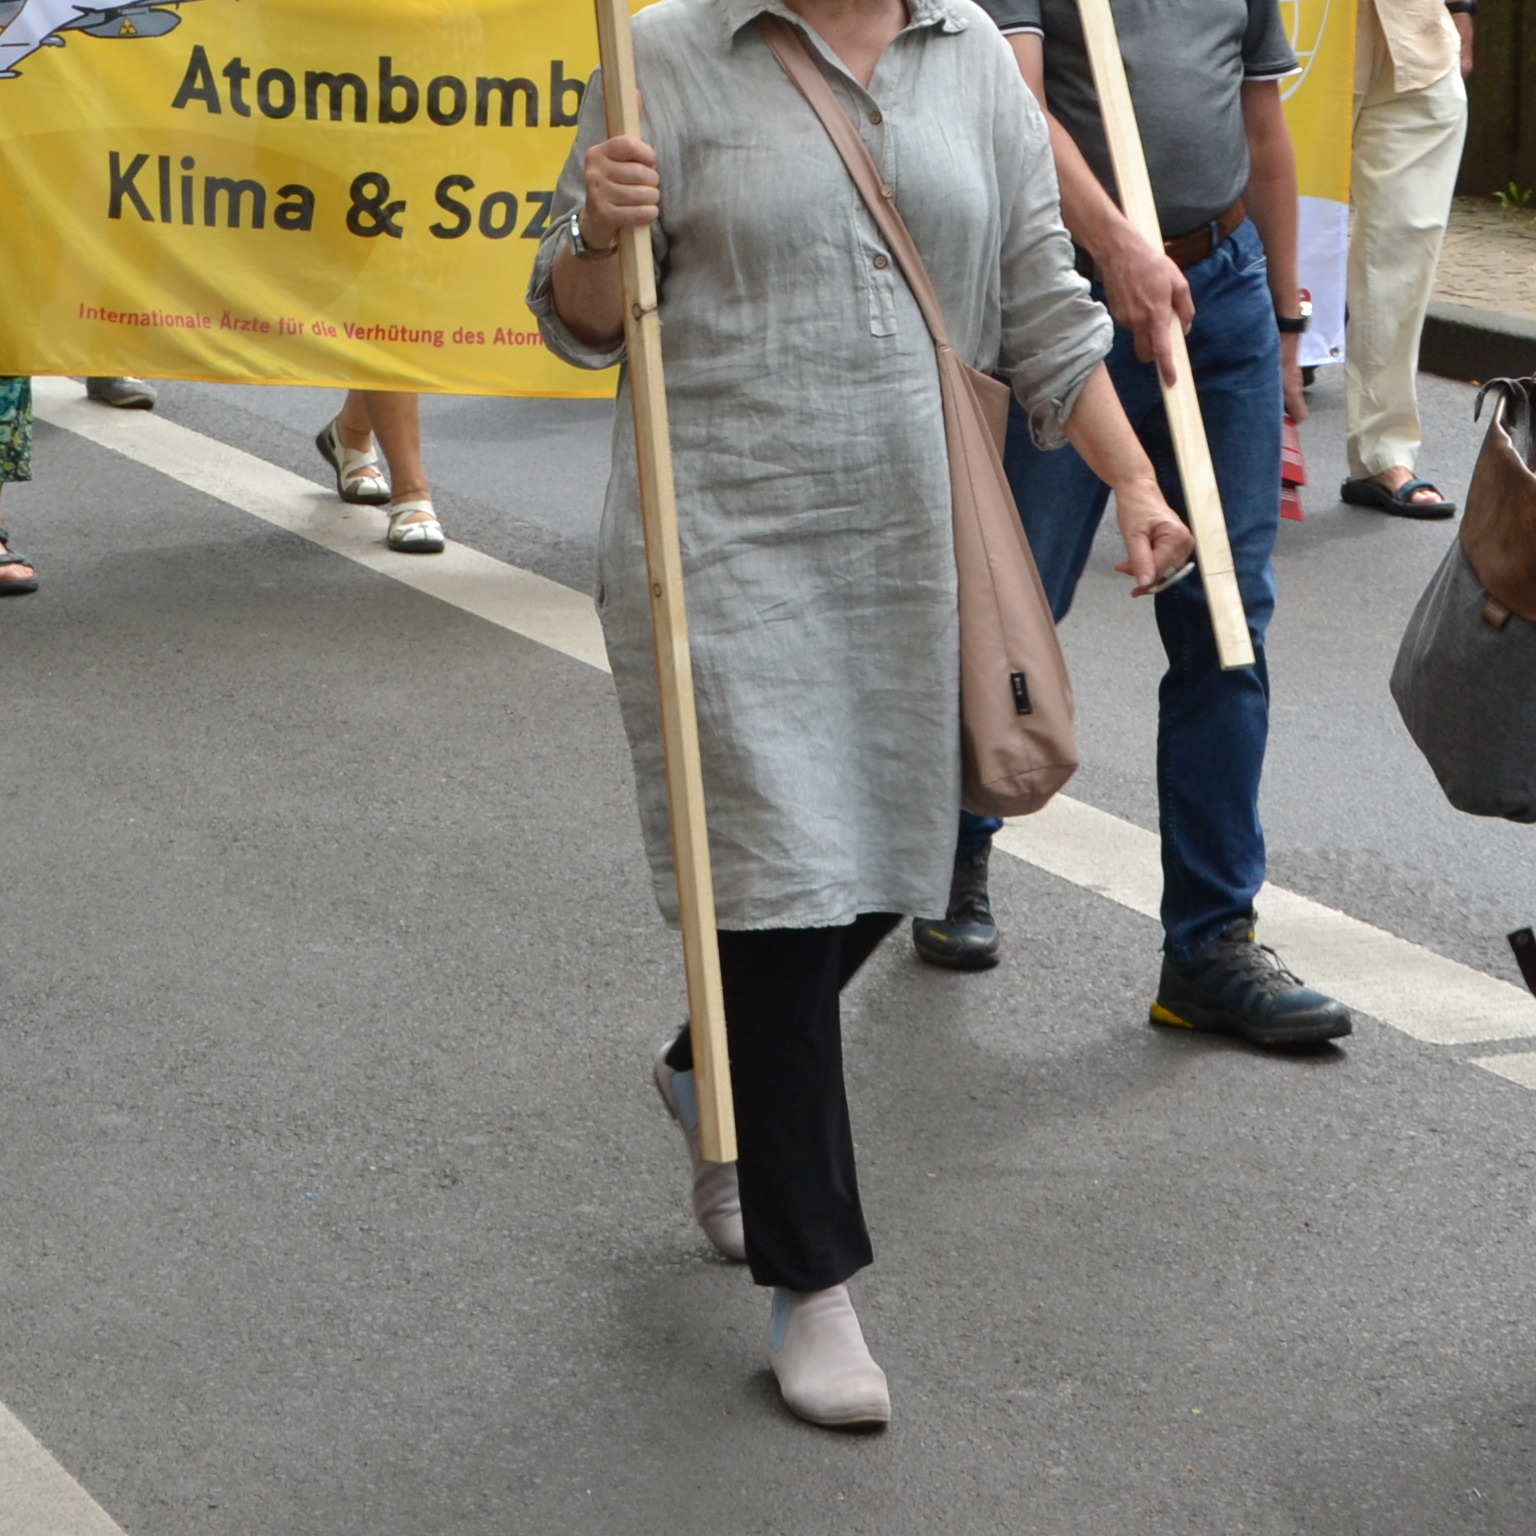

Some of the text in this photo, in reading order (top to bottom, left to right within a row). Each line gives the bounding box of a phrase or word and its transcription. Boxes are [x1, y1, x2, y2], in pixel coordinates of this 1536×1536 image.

[108, 150, 315, 231] Klima
[346, 171, 407, 239] &
[79, 302, 212, 329] Internationale
[219, 311, 270, 334] Ärzte
[279, 316, 305, 336] für
[312, 319, 338, 339] die
[343, 322, 445, 348] Verhütung
[452, 326, 486, 346] des
